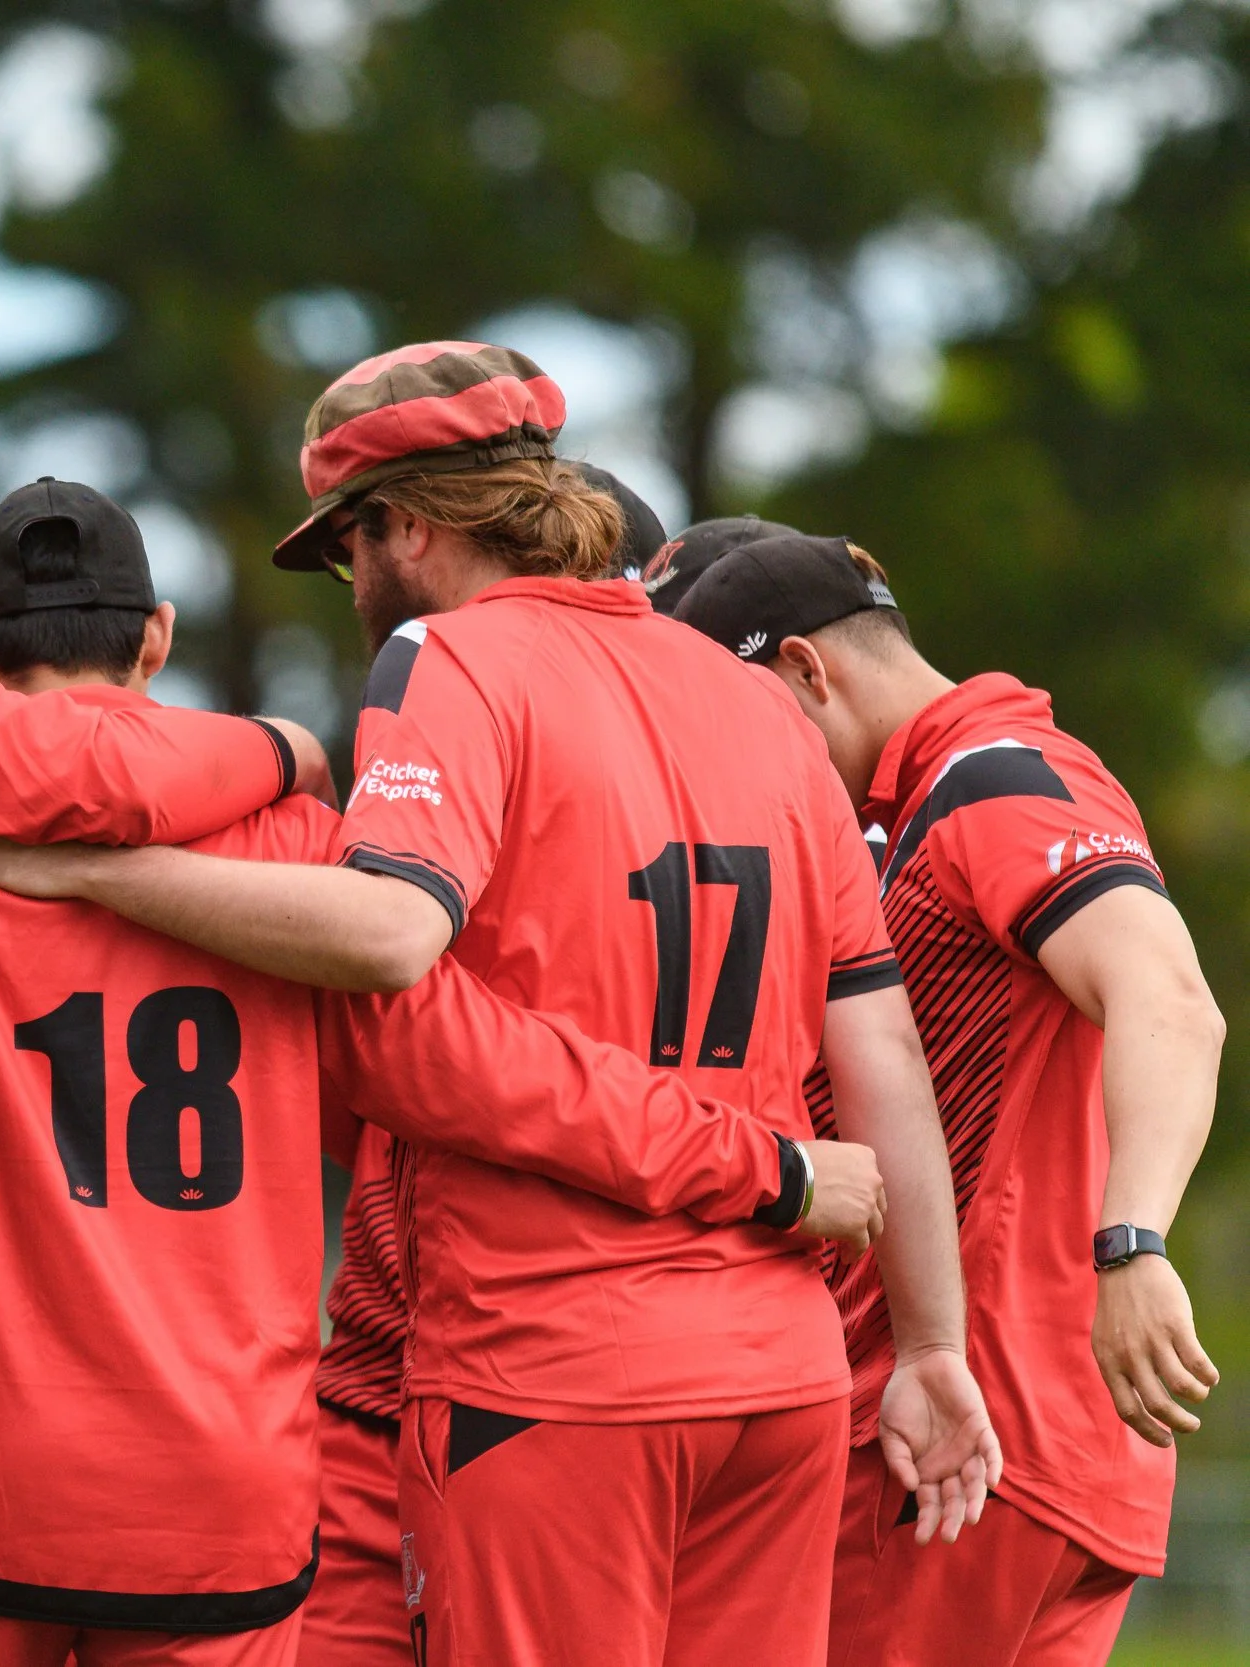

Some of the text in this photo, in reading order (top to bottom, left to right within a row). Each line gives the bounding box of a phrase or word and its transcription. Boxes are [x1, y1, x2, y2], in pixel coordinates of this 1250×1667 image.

[366, 778, 443, 806] Express
[371, 759, 440, 785] Cricket
[628, 841, 772, 1069] 17
[14, 986, 244, 1212] 18
